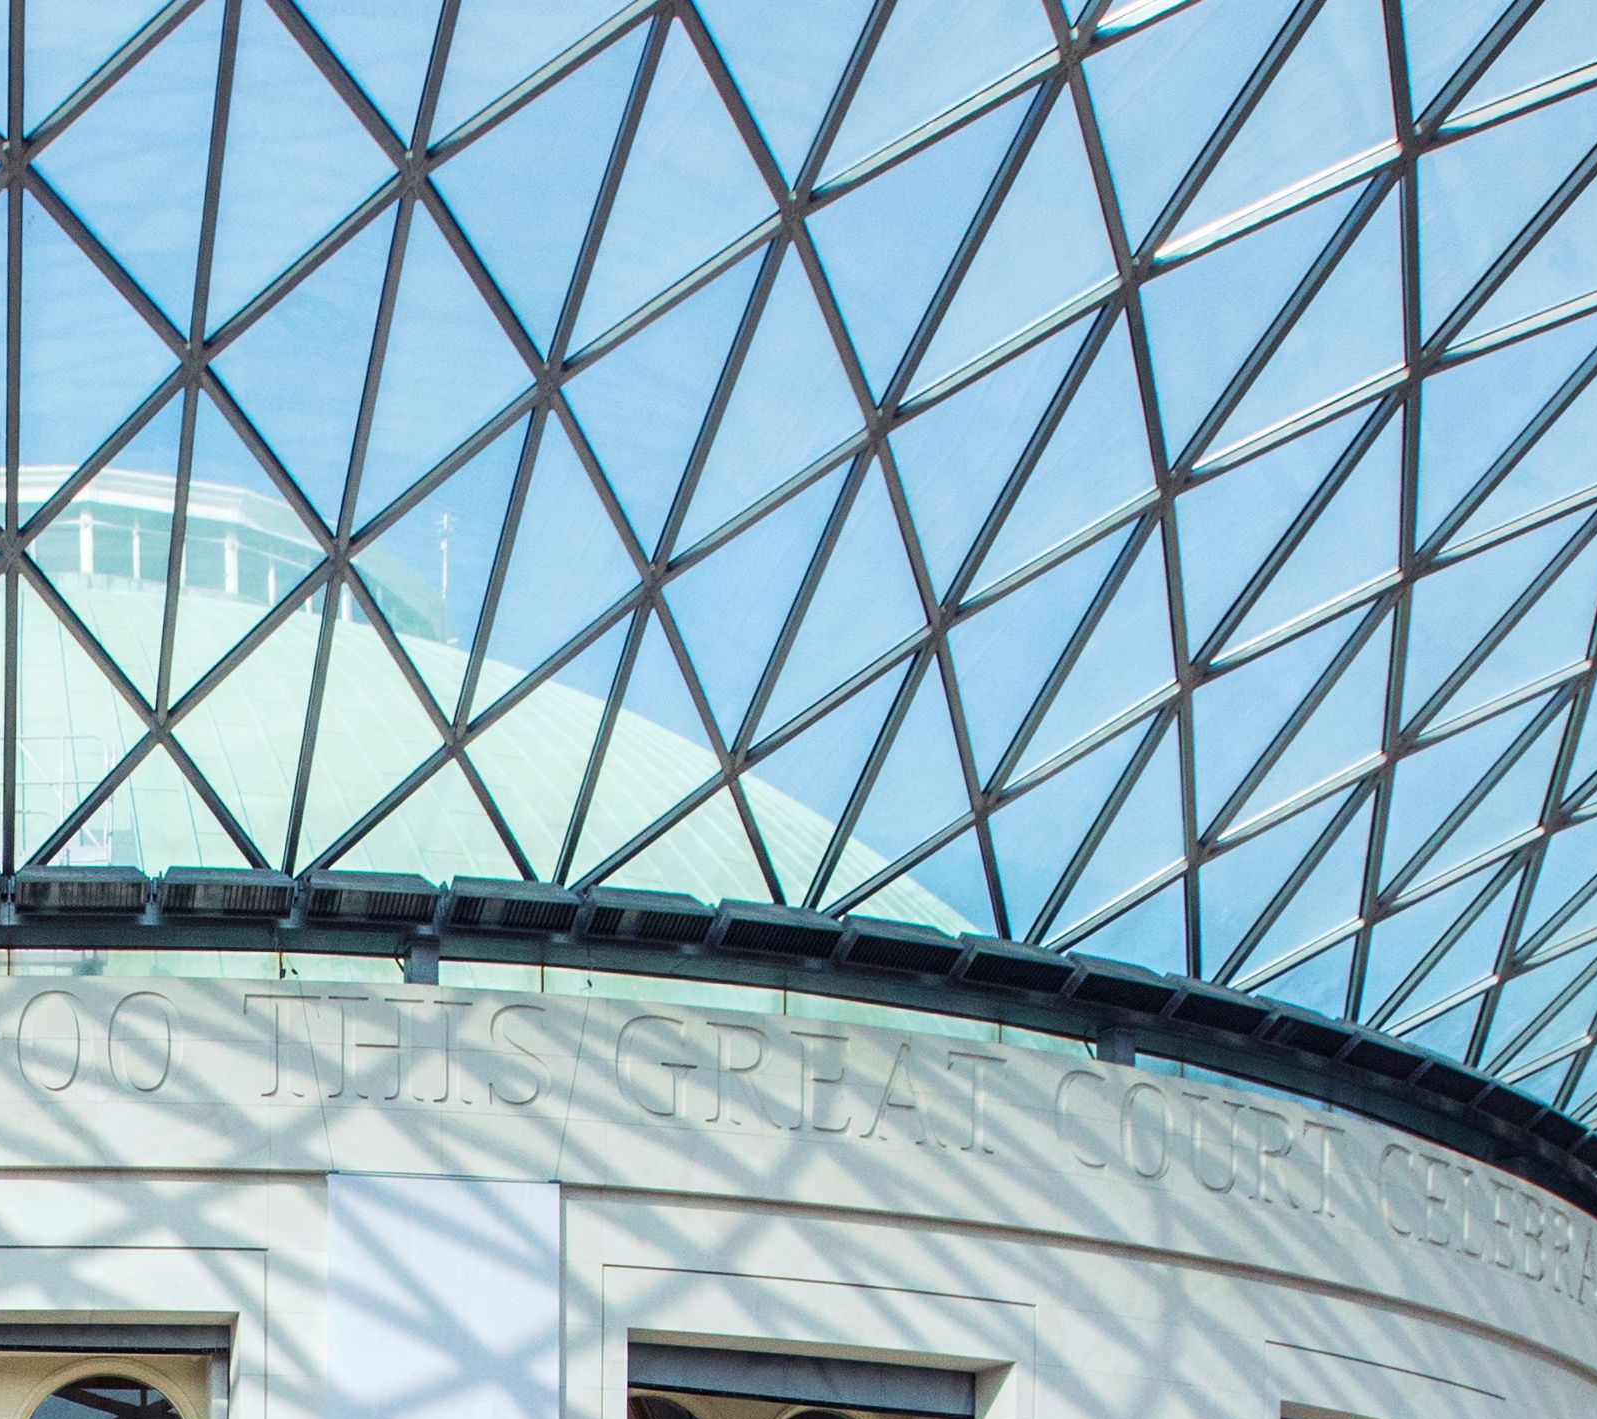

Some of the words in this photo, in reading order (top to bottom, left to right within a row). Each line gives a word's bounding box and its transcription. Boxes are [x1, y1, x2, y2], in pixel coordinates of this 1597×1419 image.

[243, 993, 551, 1106] THIS
[616, 1014, 1007, 1154] GREAT
[1055, 1069, 1345, 1218] COURT
